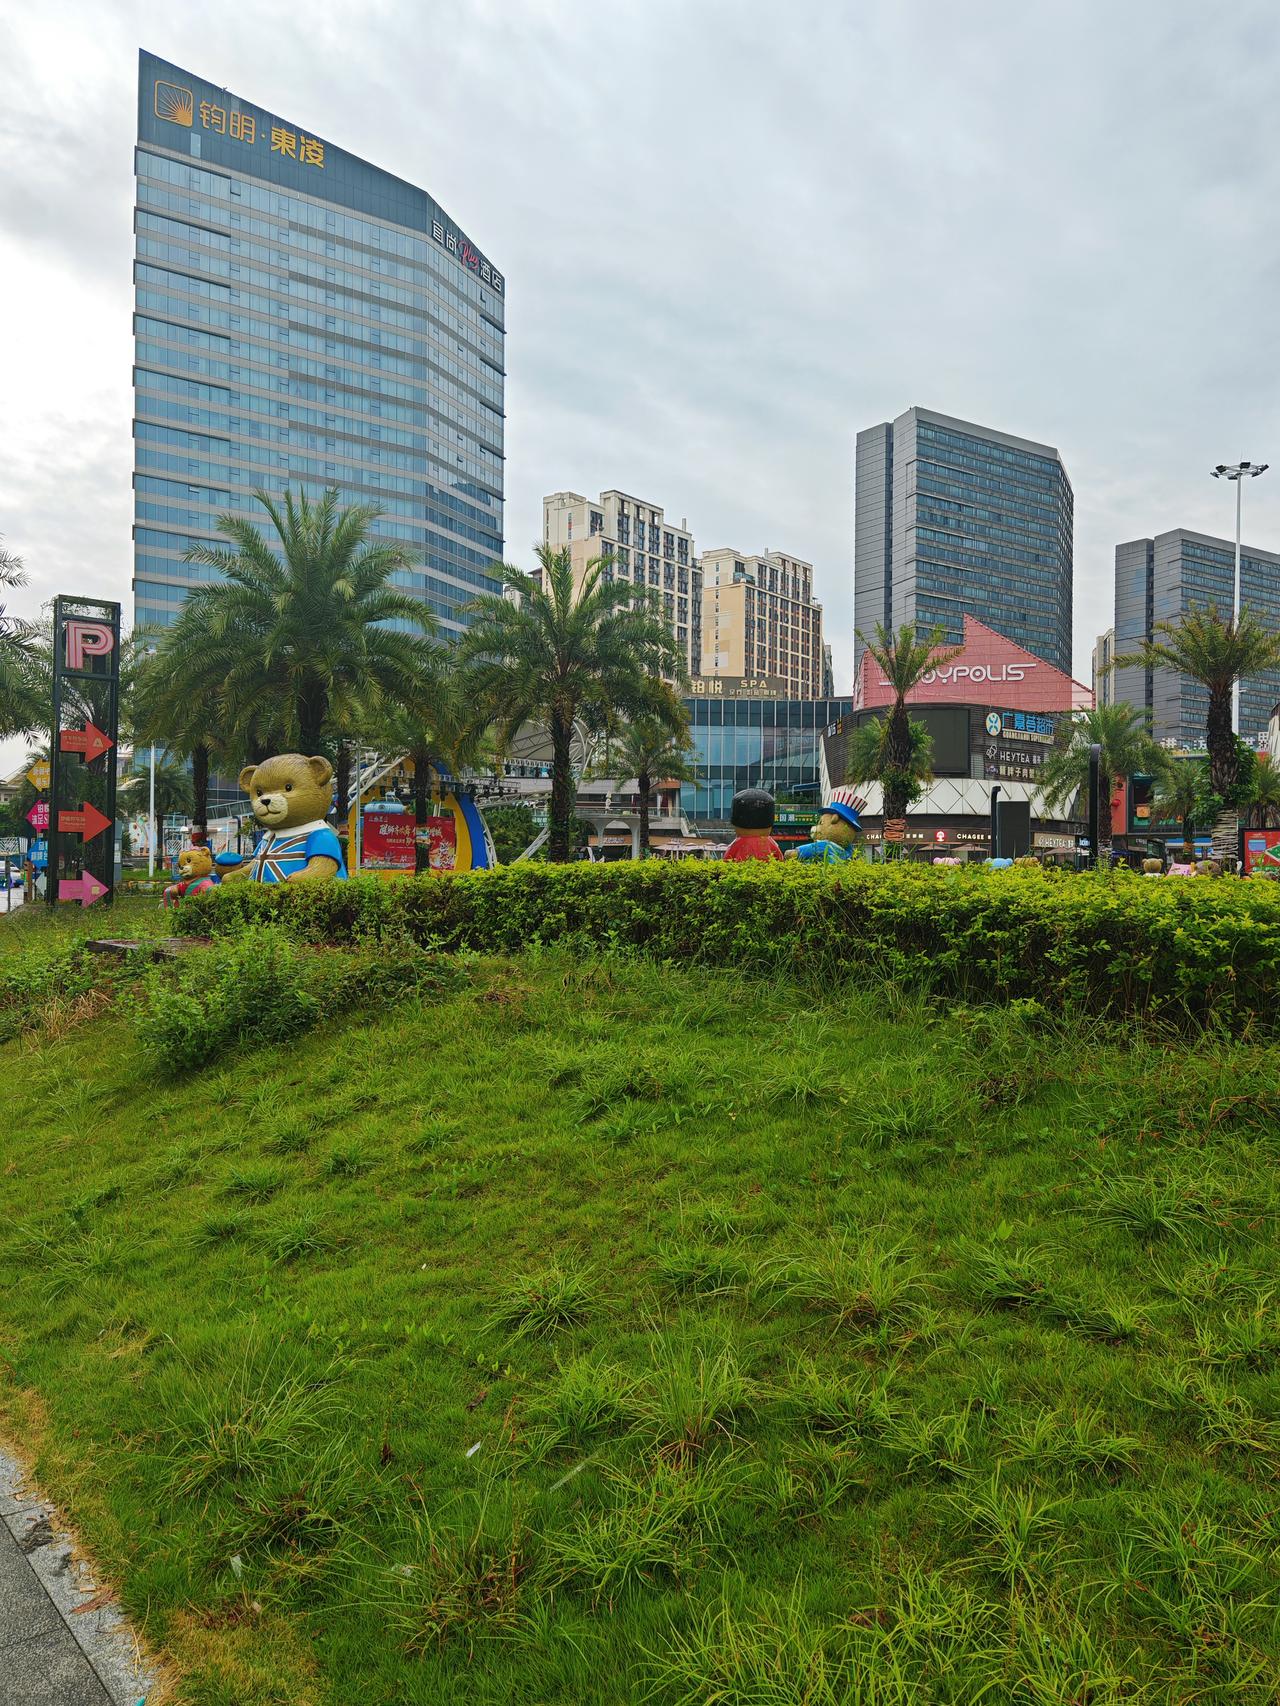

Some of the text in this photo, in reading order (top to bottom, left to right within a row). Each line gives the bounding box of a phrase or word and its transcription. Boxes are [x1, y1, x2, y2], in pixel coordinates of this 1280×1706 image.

[66, 620, 115, 670] P
[879, 663, 1036, 686] OYPOLIS
[740, 680, 767, 688] SPA
[1000, 750, 1030, 764] HEYTEA
[956, 833, 985, 841] CHAGEE
